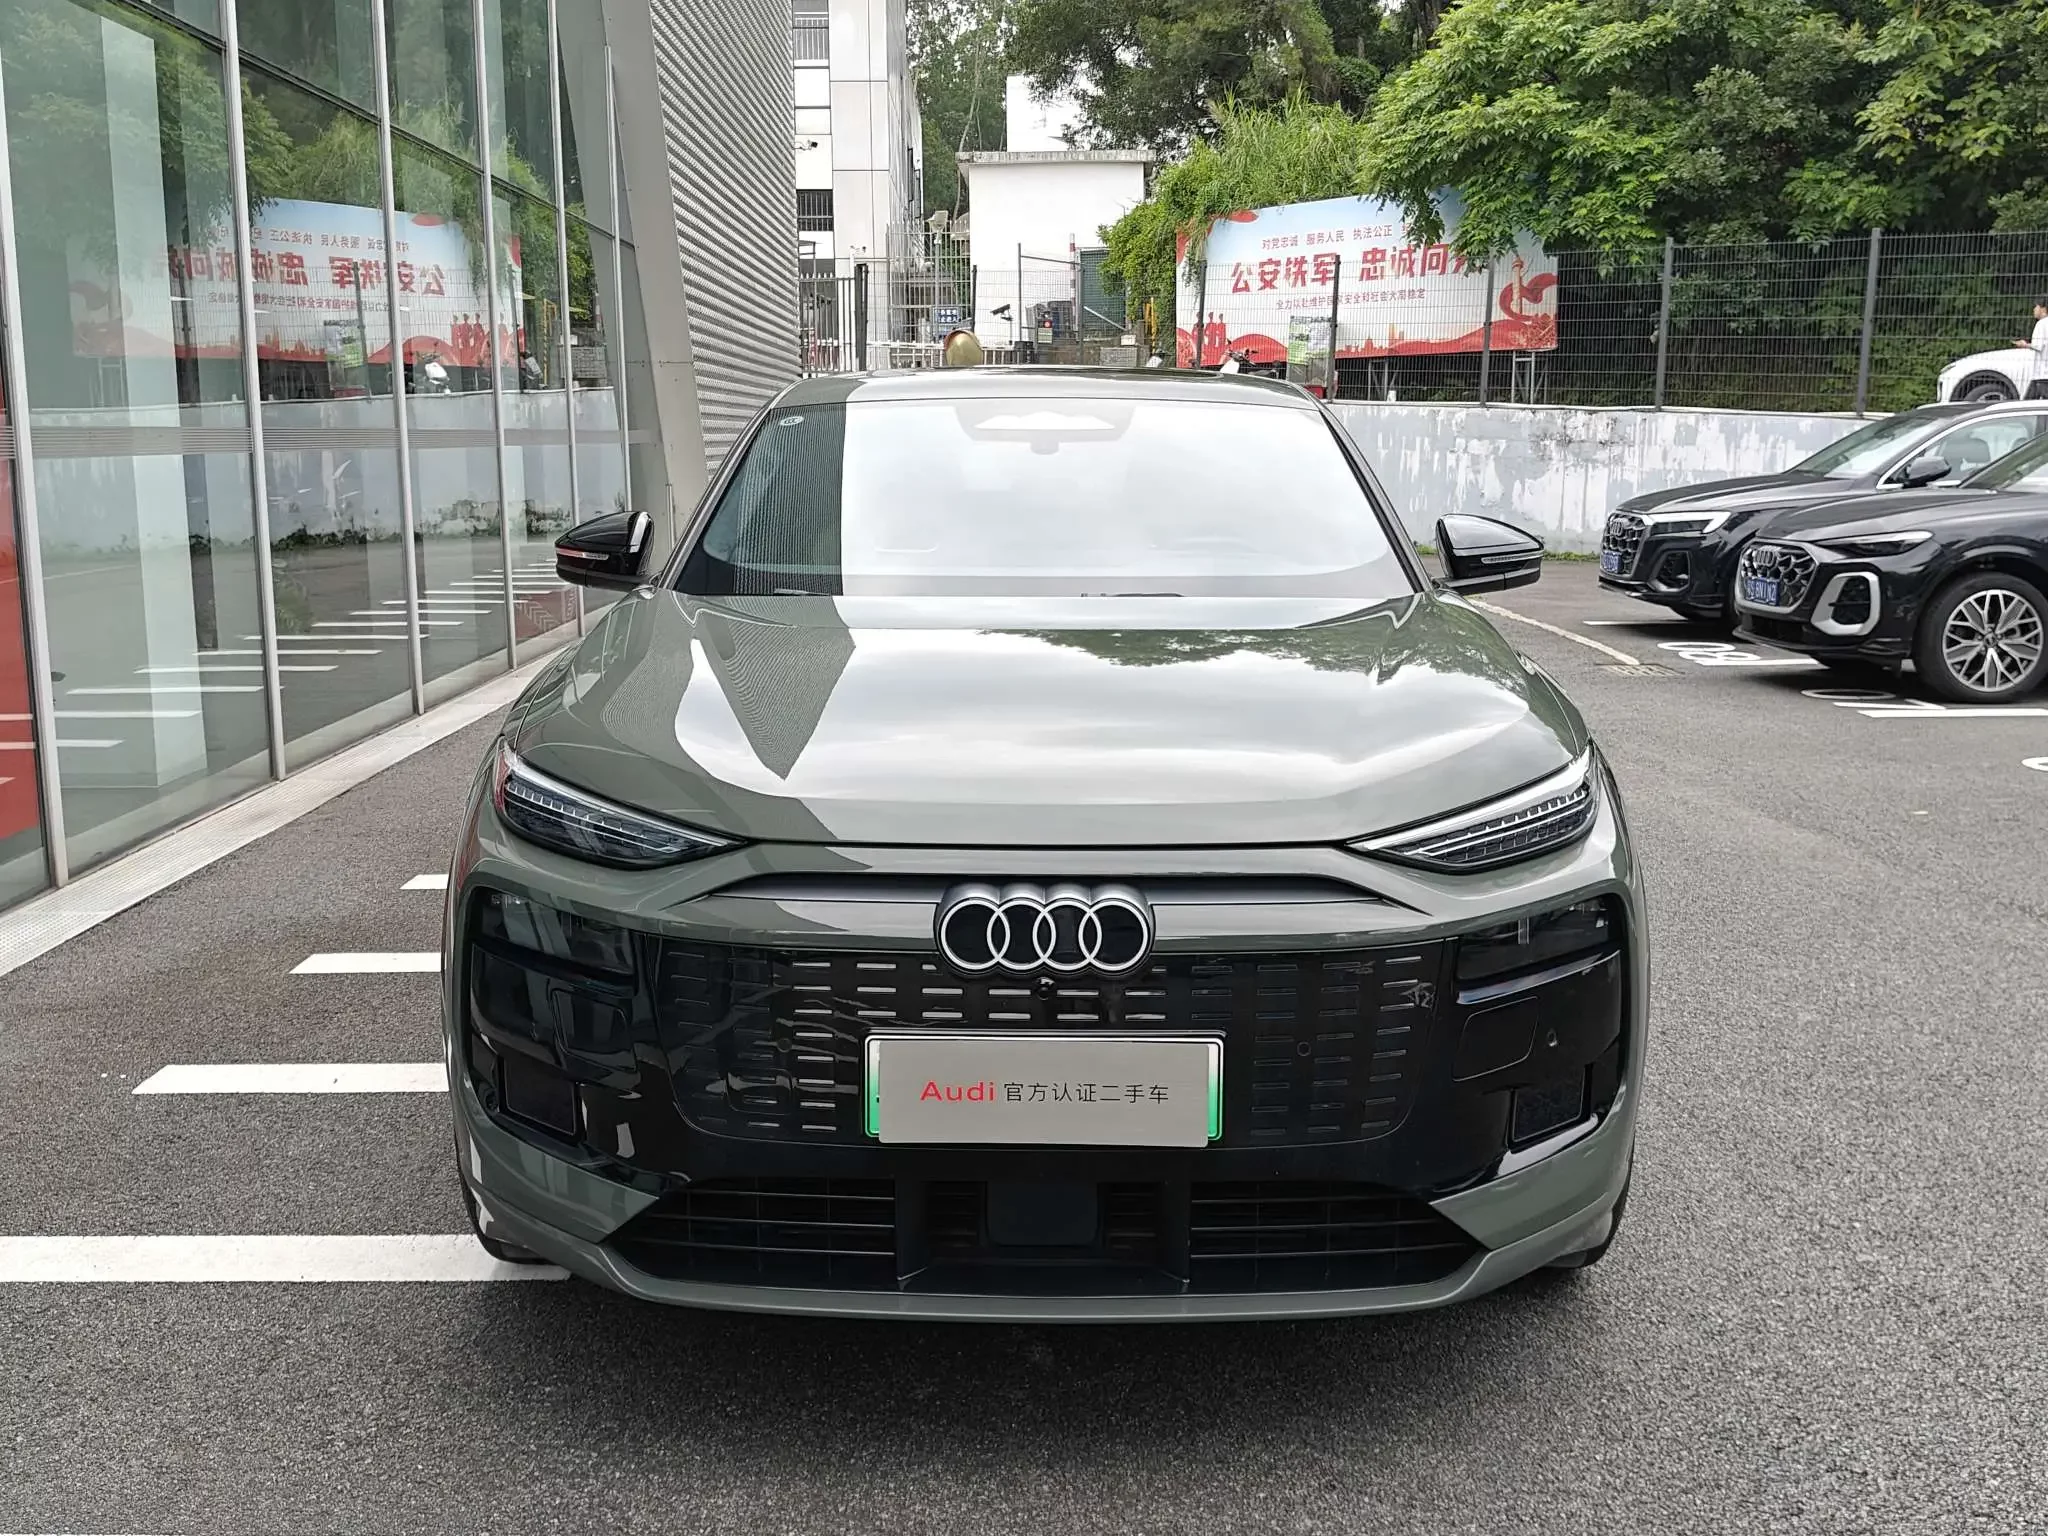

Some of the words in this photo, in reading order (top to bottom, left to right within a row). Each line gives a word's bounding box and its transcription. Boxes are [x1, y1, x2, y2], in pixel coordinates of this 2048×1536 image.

[1262, 235, 1299, 250] 对党忠诚
[1306, 230, 1345, 246] 服务人民
[1353, 225, 1393, 240] 执法公正
[1231, 252, 1338, 293] 公安铁军
[919, 1080, 996, 1102] Audi
[1003, 1081, 1170, 1105] 官方认证二手车
